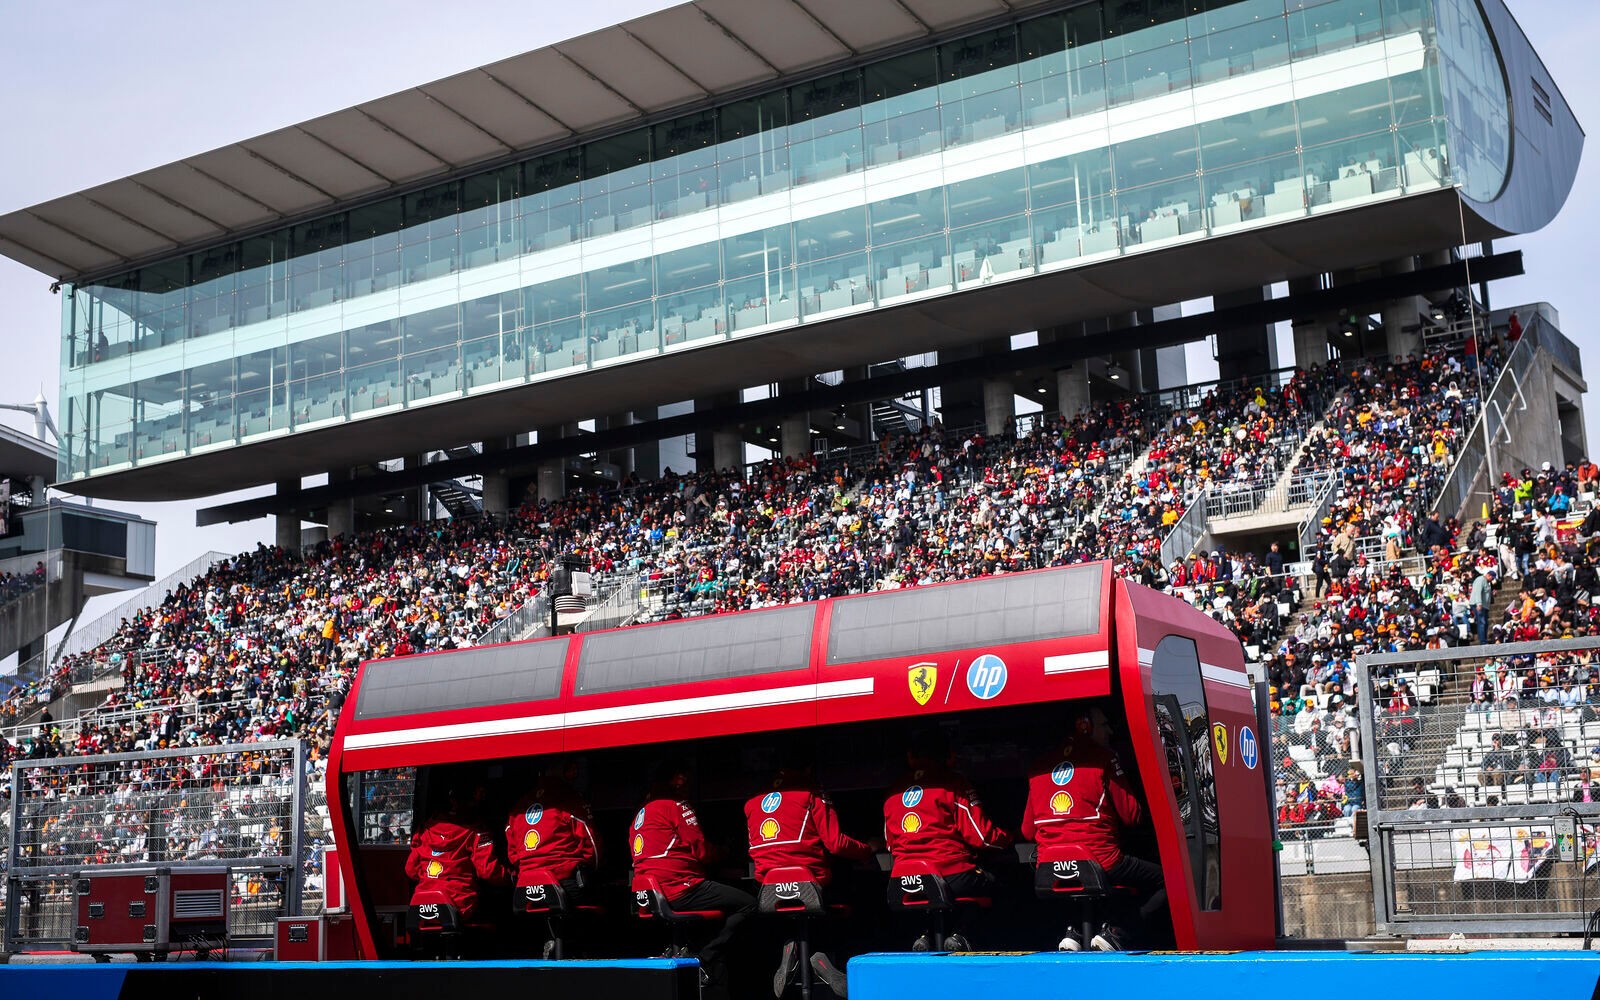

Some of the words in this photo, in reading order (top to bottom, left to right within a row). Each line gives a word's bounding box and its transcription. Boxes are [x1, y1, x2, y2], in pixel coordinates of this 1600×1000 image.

[971, 654, 1003, 699] hp
[1242, 727, 1256, 768] hp
[1054, 762, 1073, 785] hp
[763, 792, 781, 813] hp
[904, 786, 922, 807] hp
[527, 804, 542, 824] hp
[1053, 860, 1078, 871] aws
[775, 881, 799, 892] aws
[901, 874, 922, 886] aws
[526, 884, 545, 895] aws
[636, 890, 648, 900] aws
[419, 903, 438, 913] aws
